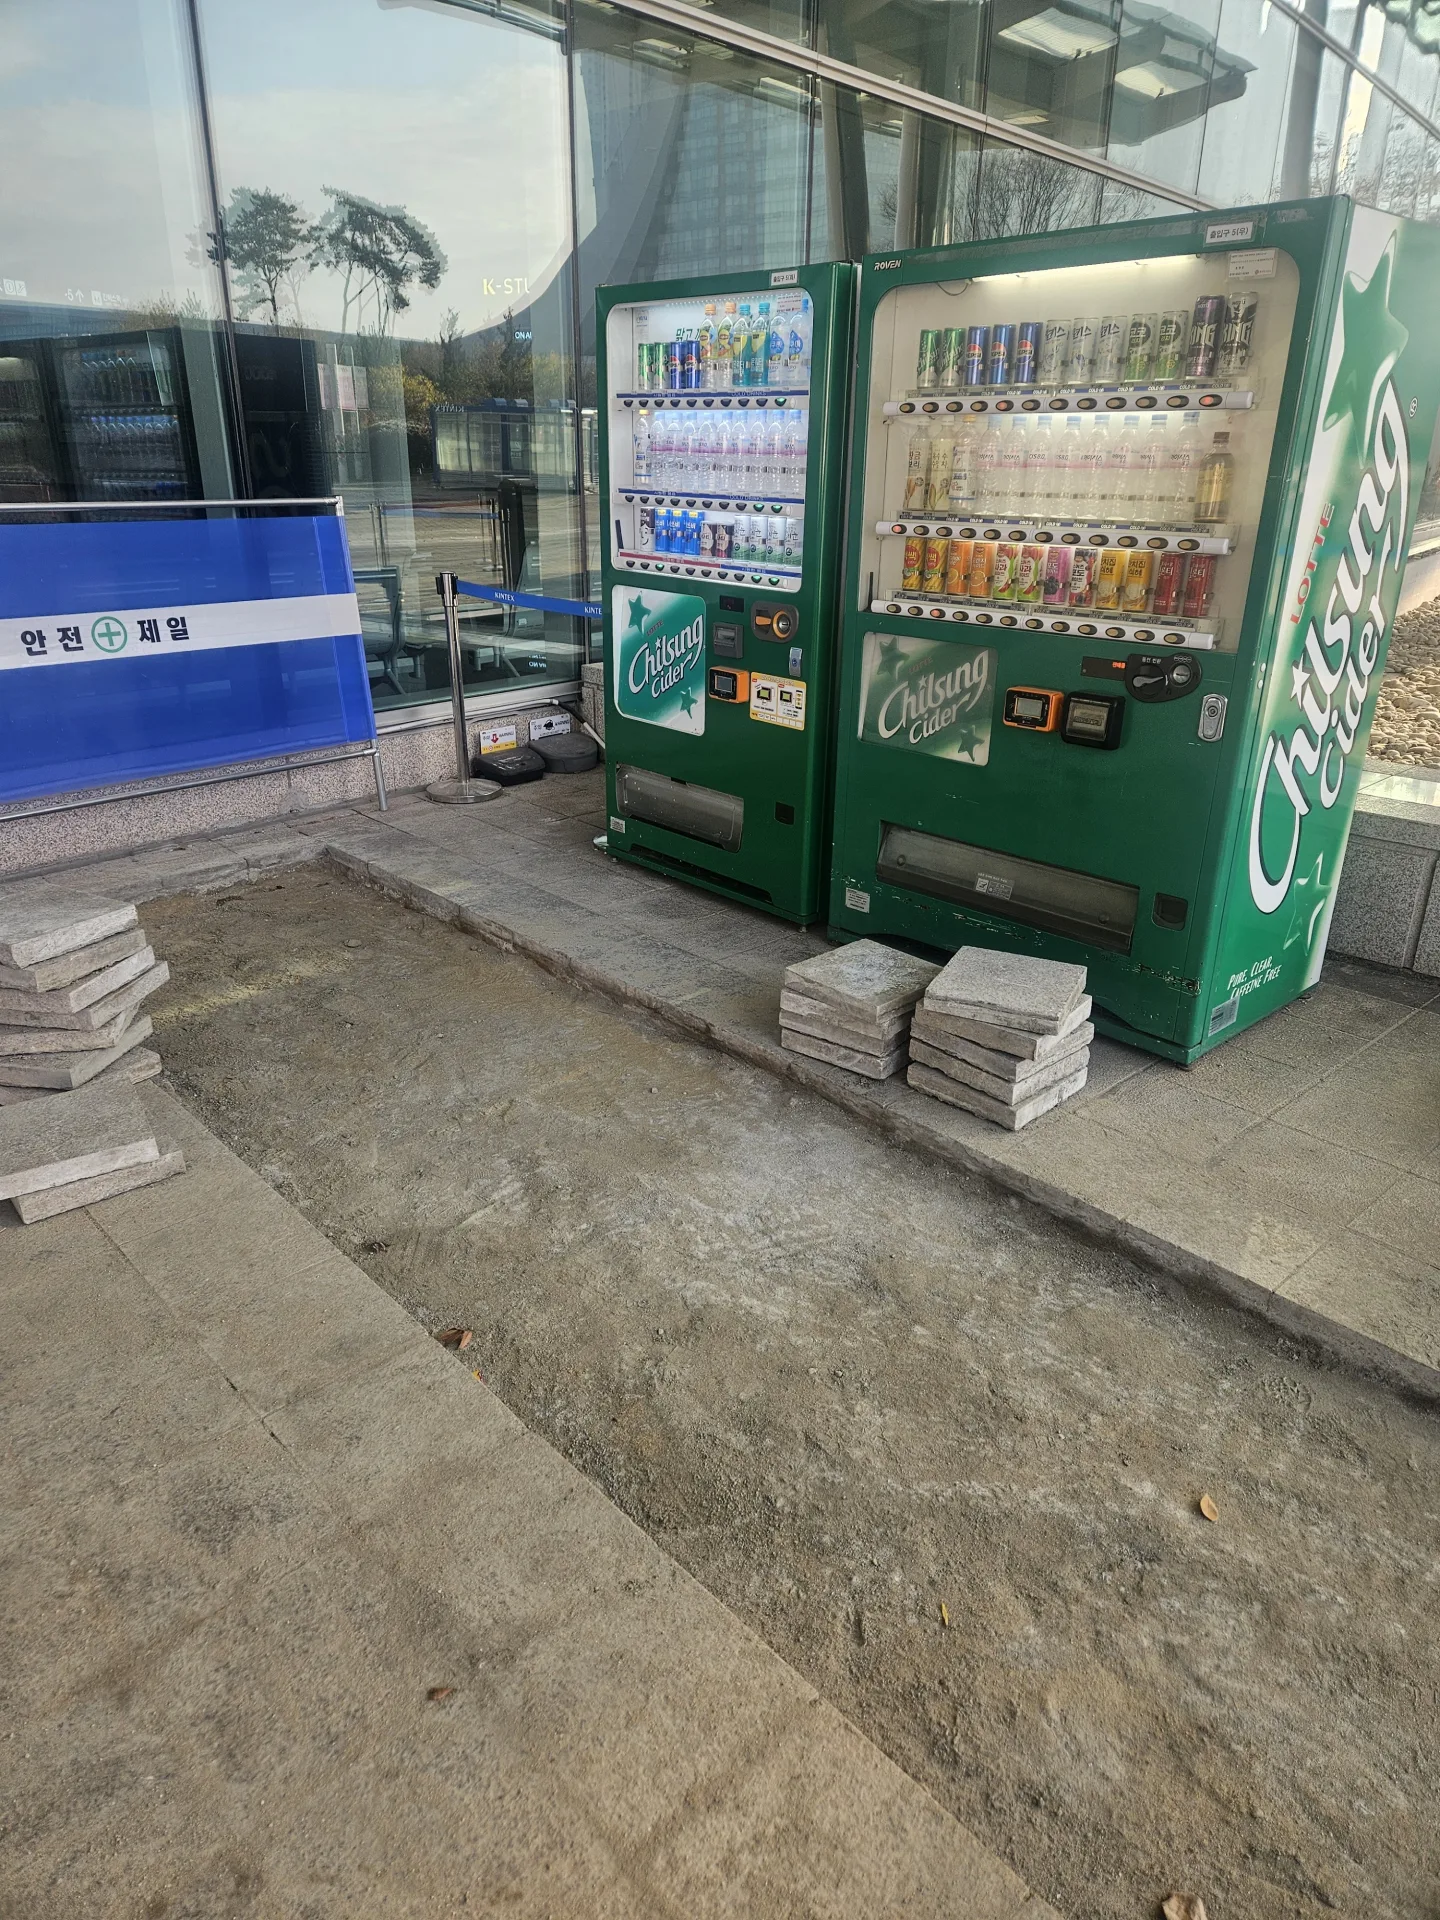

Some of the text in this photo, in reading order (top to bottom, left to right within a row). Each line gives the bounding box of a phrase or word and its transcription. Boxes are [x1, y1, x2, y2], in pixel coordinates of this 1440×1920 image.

[1210, 226, 1248, 239] 출입구 5(우)
[874, 260, 902, 270] ROVEN
[676, 328, 693, 341] 맑고
[1290, 503, 1334, 624] LOTTE
[494, 592, 515, 601] KINTEX
[628, 615, 703, 694] Chilsung
[1250, 378, 1408, 913] Chilsung
[1320, 522, 1391, 808] Cider
[652, 652, 692, 698] Cider
[878, 650, 989, 738] Chilsung
[910, 692, 971, 744] Cider
[1227, 956, 1272, 990] PURE, CLEAR,
[1230, 965, 1282, 1000] CAFFEINE FREE
